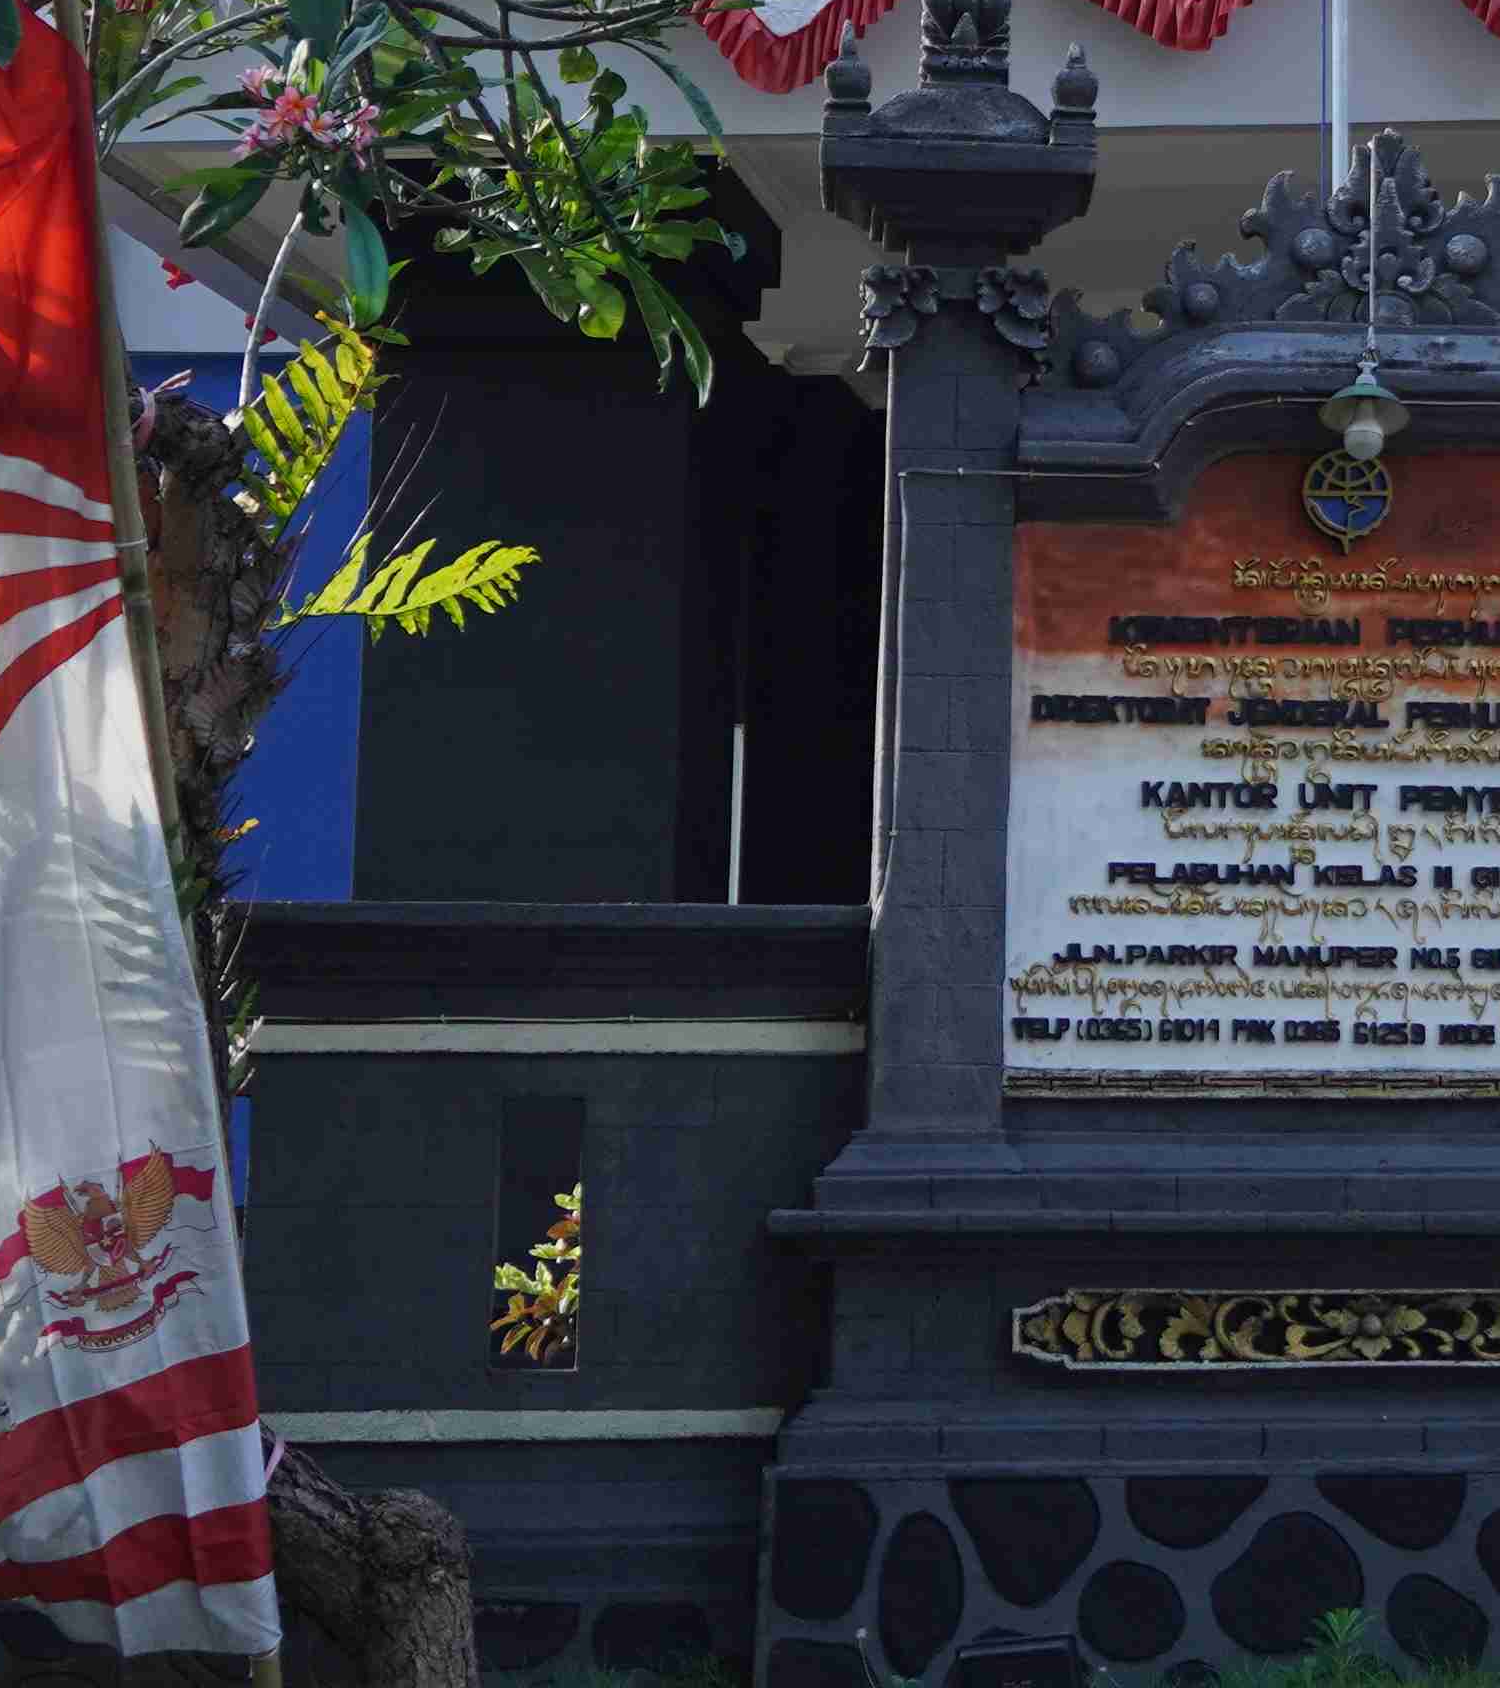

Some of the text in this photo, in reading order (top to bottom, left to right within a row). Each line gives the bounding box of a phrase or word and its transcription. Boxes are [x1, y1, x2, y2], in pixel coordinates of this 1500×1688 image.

[1141, 780, 1279, 810] KANTOR
[1298, 783, 1379, 811] UNIT
[1108, 862, 1295, 886] PELABUHAN
[1313, 864, 1418, 888] KELAS
